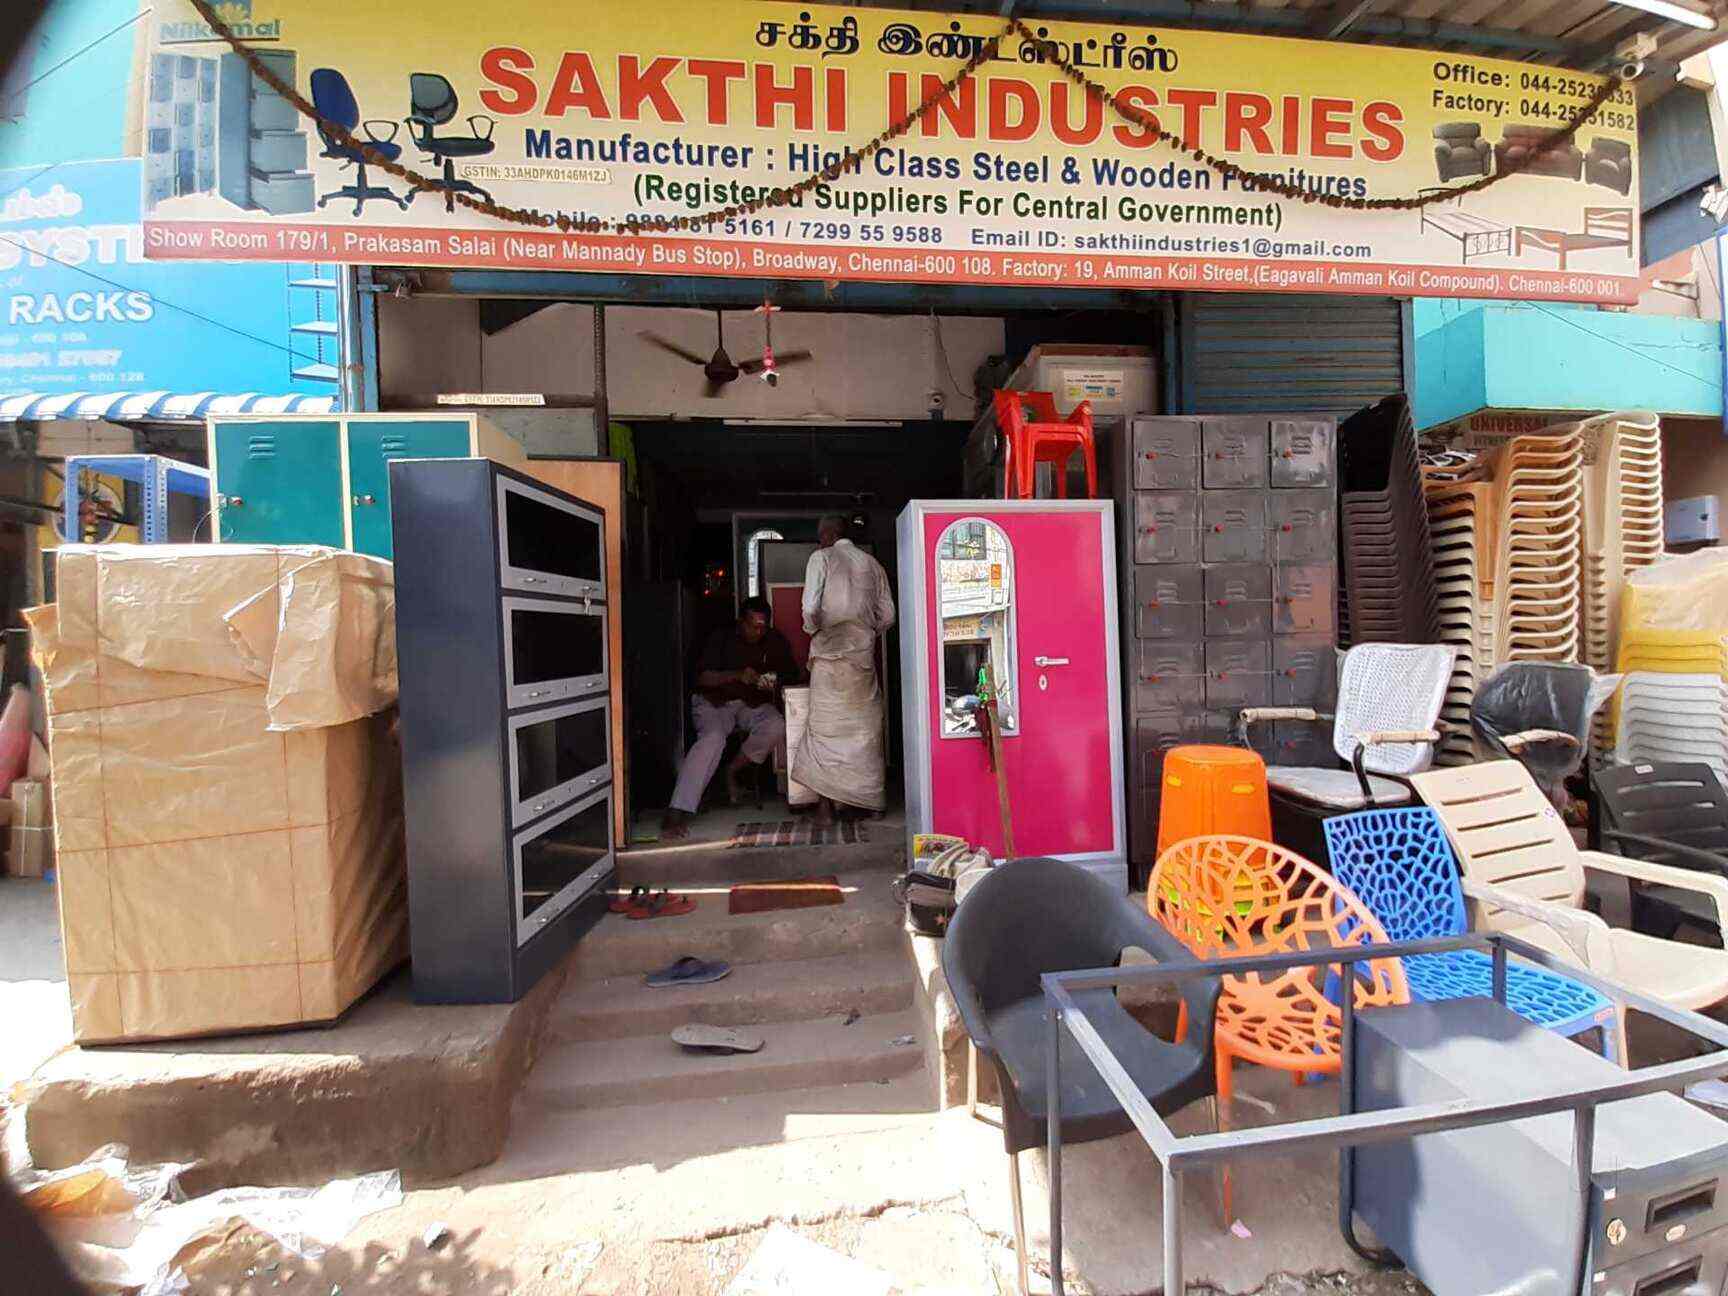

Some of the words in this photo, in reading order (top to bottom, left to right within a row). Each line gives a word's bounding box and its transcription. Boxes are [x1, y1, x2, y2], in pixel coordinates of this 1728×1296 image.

[159, 19, 280, 40] Nilkmal
[755, 11, 860, 61] சக்தி
[1433, 61, 1510, 88] Office:
[478, 46, 848, 134] SAKTHI
[885, 71, 1406, 163] INDUSTRIES
[1432, 90, 1510, 117] Factory:
[525, 128, 753, 168] Manufacturer
[766, 148, 773, 170] :
[788, 142, 862, 181] High
[874, 147, 960, 179] Class
[973, 151, 1049, 183] Steel
[1061, 156, 1081, 185] &
[1092, 157, 1210, 190] Wooden
[1221, 166, 1367, 198] Funitures
[633, 173, 804, 210] (Registered
[814, 183, 948, 217] Suppliers
[959, 189, 1003, 217] For
[1012, 191, 1108, 220] Central
[1117, 196, 1282, 233] Government)
[724, 217, 776, 237] 5161
[784, 220, 792, 238] /
[799, 221, 851, 239] 7299
[860, 224, 885, 241] 55
[892, 226, 943, 244] 9588
[971, 228, 1030, 247] Email
[1037, 231, 1067, 248] ID:
[1073, 232, 1373, 258] sakthiindustries1@gmail.com
[150, 228, 203, 248] Show
[210, 228, 268, 249] Room
[276, 230, 337, 253] 179/1,
[344, 232, 441, 254] Prakasam
[448, 235, 496, 256] Salai
[503, 237, 556, 261] (Near
[561, 240, 646, 266] Mannady
[652, 246, 687, 263] Bus
[692, 247, 746, 269] Stop),
[848, 253, 956, 275] Chennai-600
[1002, 257, 1068, 282] Factory:
[1073, 260, 1099, 281] 19,
[1103, 261, 1162, 281] Amman
[1168, 263, 1197, 281] Koil
[1327, 268, 1384, 287] Amman
[1388, 269, 1415, 288] Koil
[1508, 272, 1594, 295] Chennai-600
[8, 289, 156, 325] RACKS
